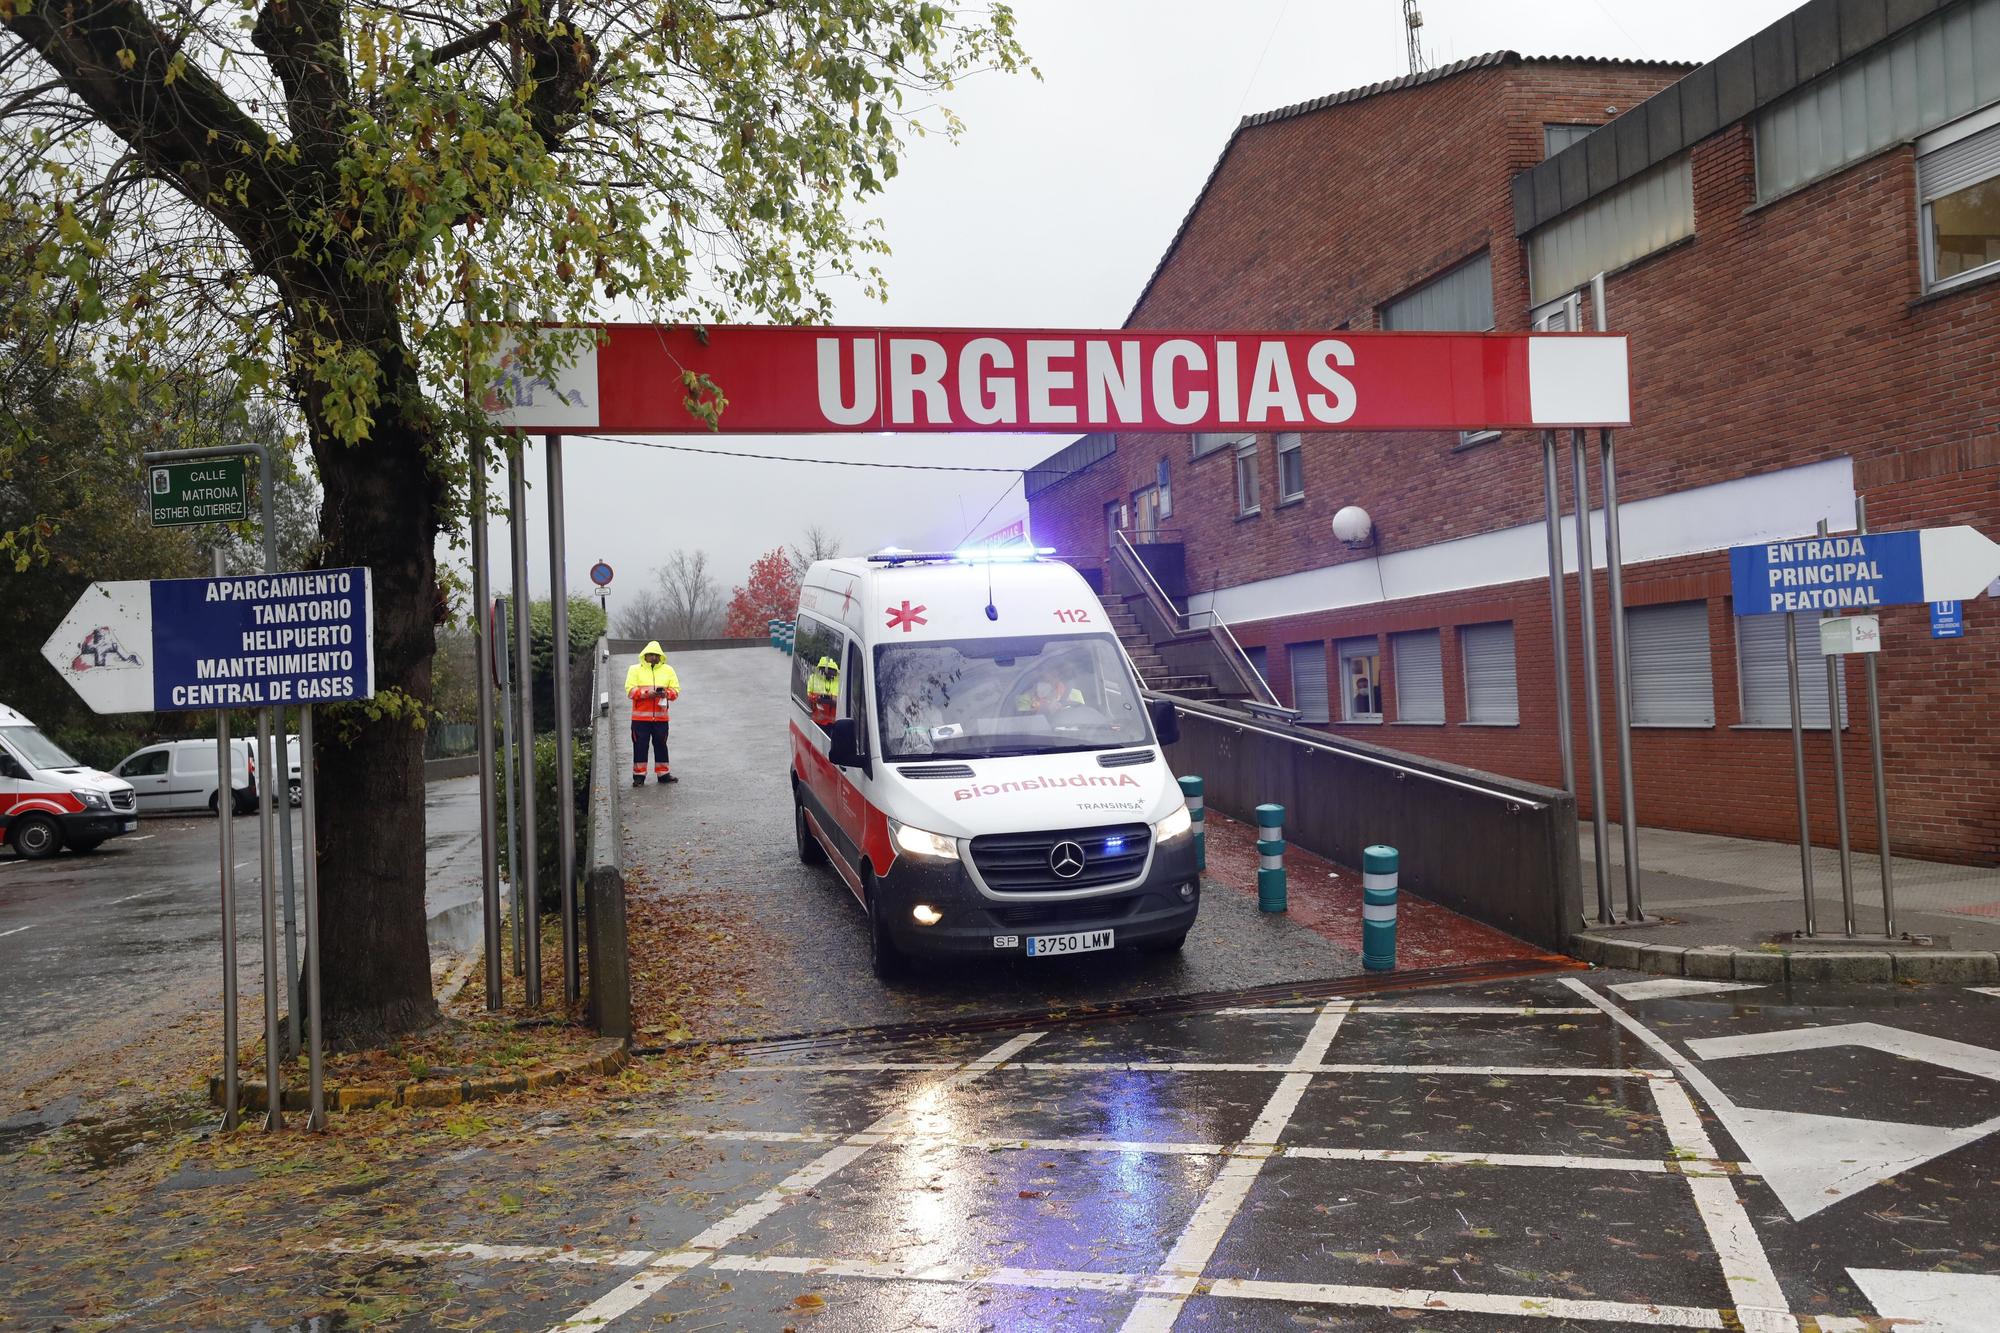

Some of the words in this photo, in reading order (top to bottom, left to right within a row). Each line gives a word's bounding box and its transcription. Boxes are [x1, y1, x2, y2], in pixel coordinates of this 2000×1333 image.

[816, 337, 1358, 425] URGENCIAS
[190, 469, 226, 482] CALLE
[182, 486, 238, 501] MATRONA
[154, 506, 189, 520] ESTHER
[192, 502, 242, 517] GUTIERREZ
[1767, 538, 1865, 564] ENTRADA
[1769, 561, 1883, 588] PRINCIPAL
[205, 573, 351, 602] APARCAMIENTO
[1770, 586, 1880, 612] PEATONAL
[253, 599, 352, 624] TANATORIO
[1053, 609, 1091, 623] 112
[242, 625, 352, 652] HELIPUERTO
[197, 650, 353, 679] MANTENIMIENTO
[172, 682, 264, 705] CENTRAL
[269, 681, 292, 701] DE
[297, 676, 353, 700] GASES
[1076, 802, 1143, 811] TRANSINSA
[995, 936, 1017, 947] SP
[1038, 936, 1077, 953] 3750
[1082, 932, 1111, 949] LMW
